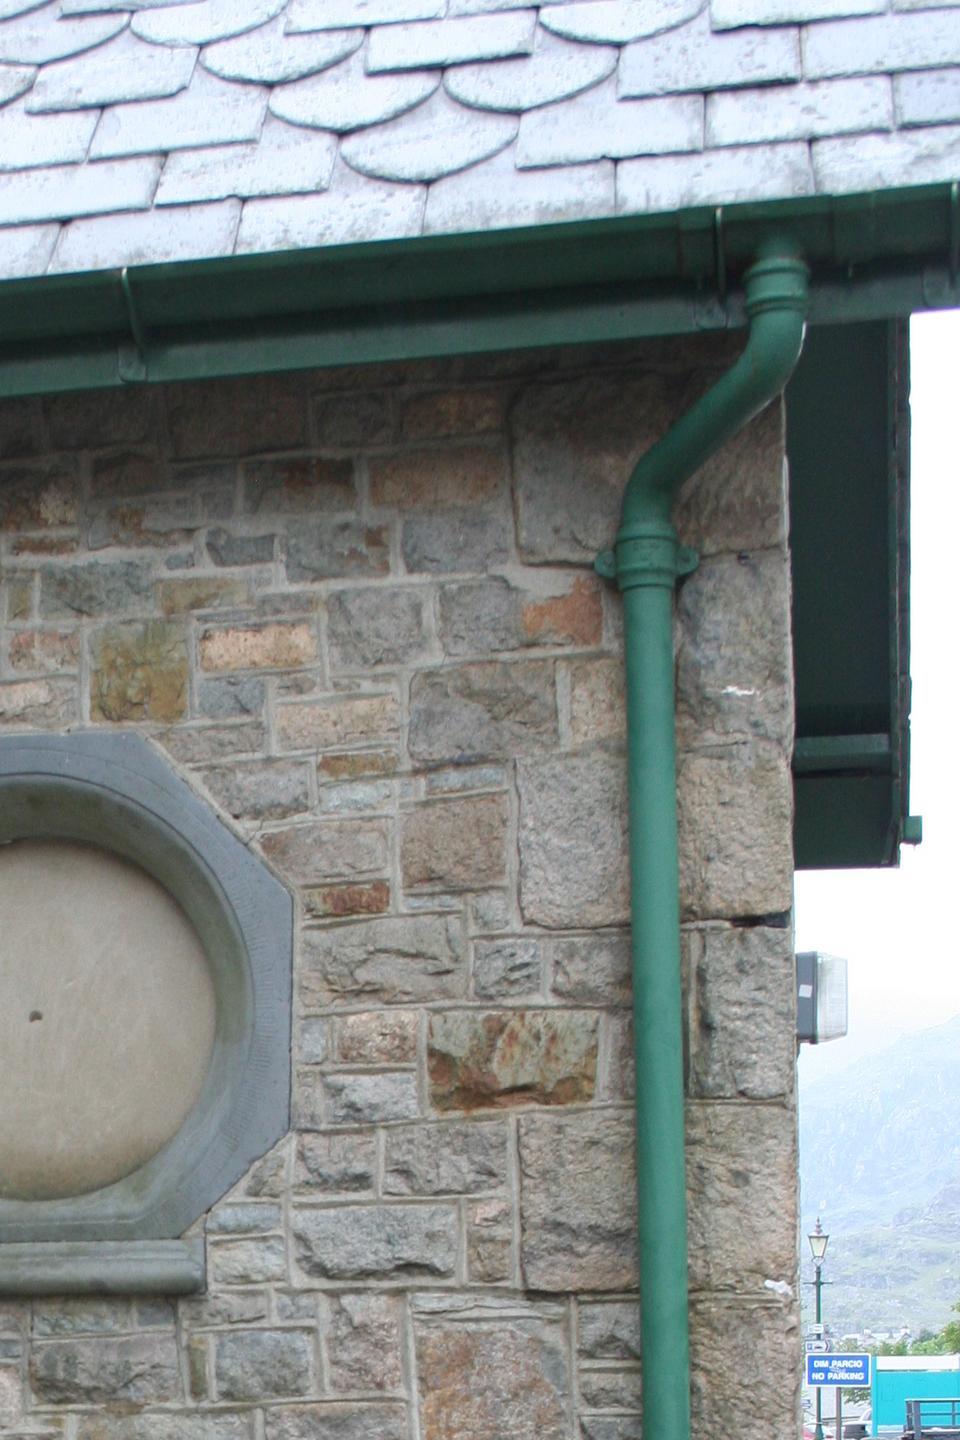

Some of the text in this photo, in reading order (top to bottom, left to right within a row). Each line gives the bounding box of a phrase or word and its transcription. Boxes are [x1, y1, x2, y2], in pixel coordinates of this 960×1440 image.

[813, 1360, 863, 1368] DIM PARCIO
[812, 1372, 865, 1380] NO PARKING
